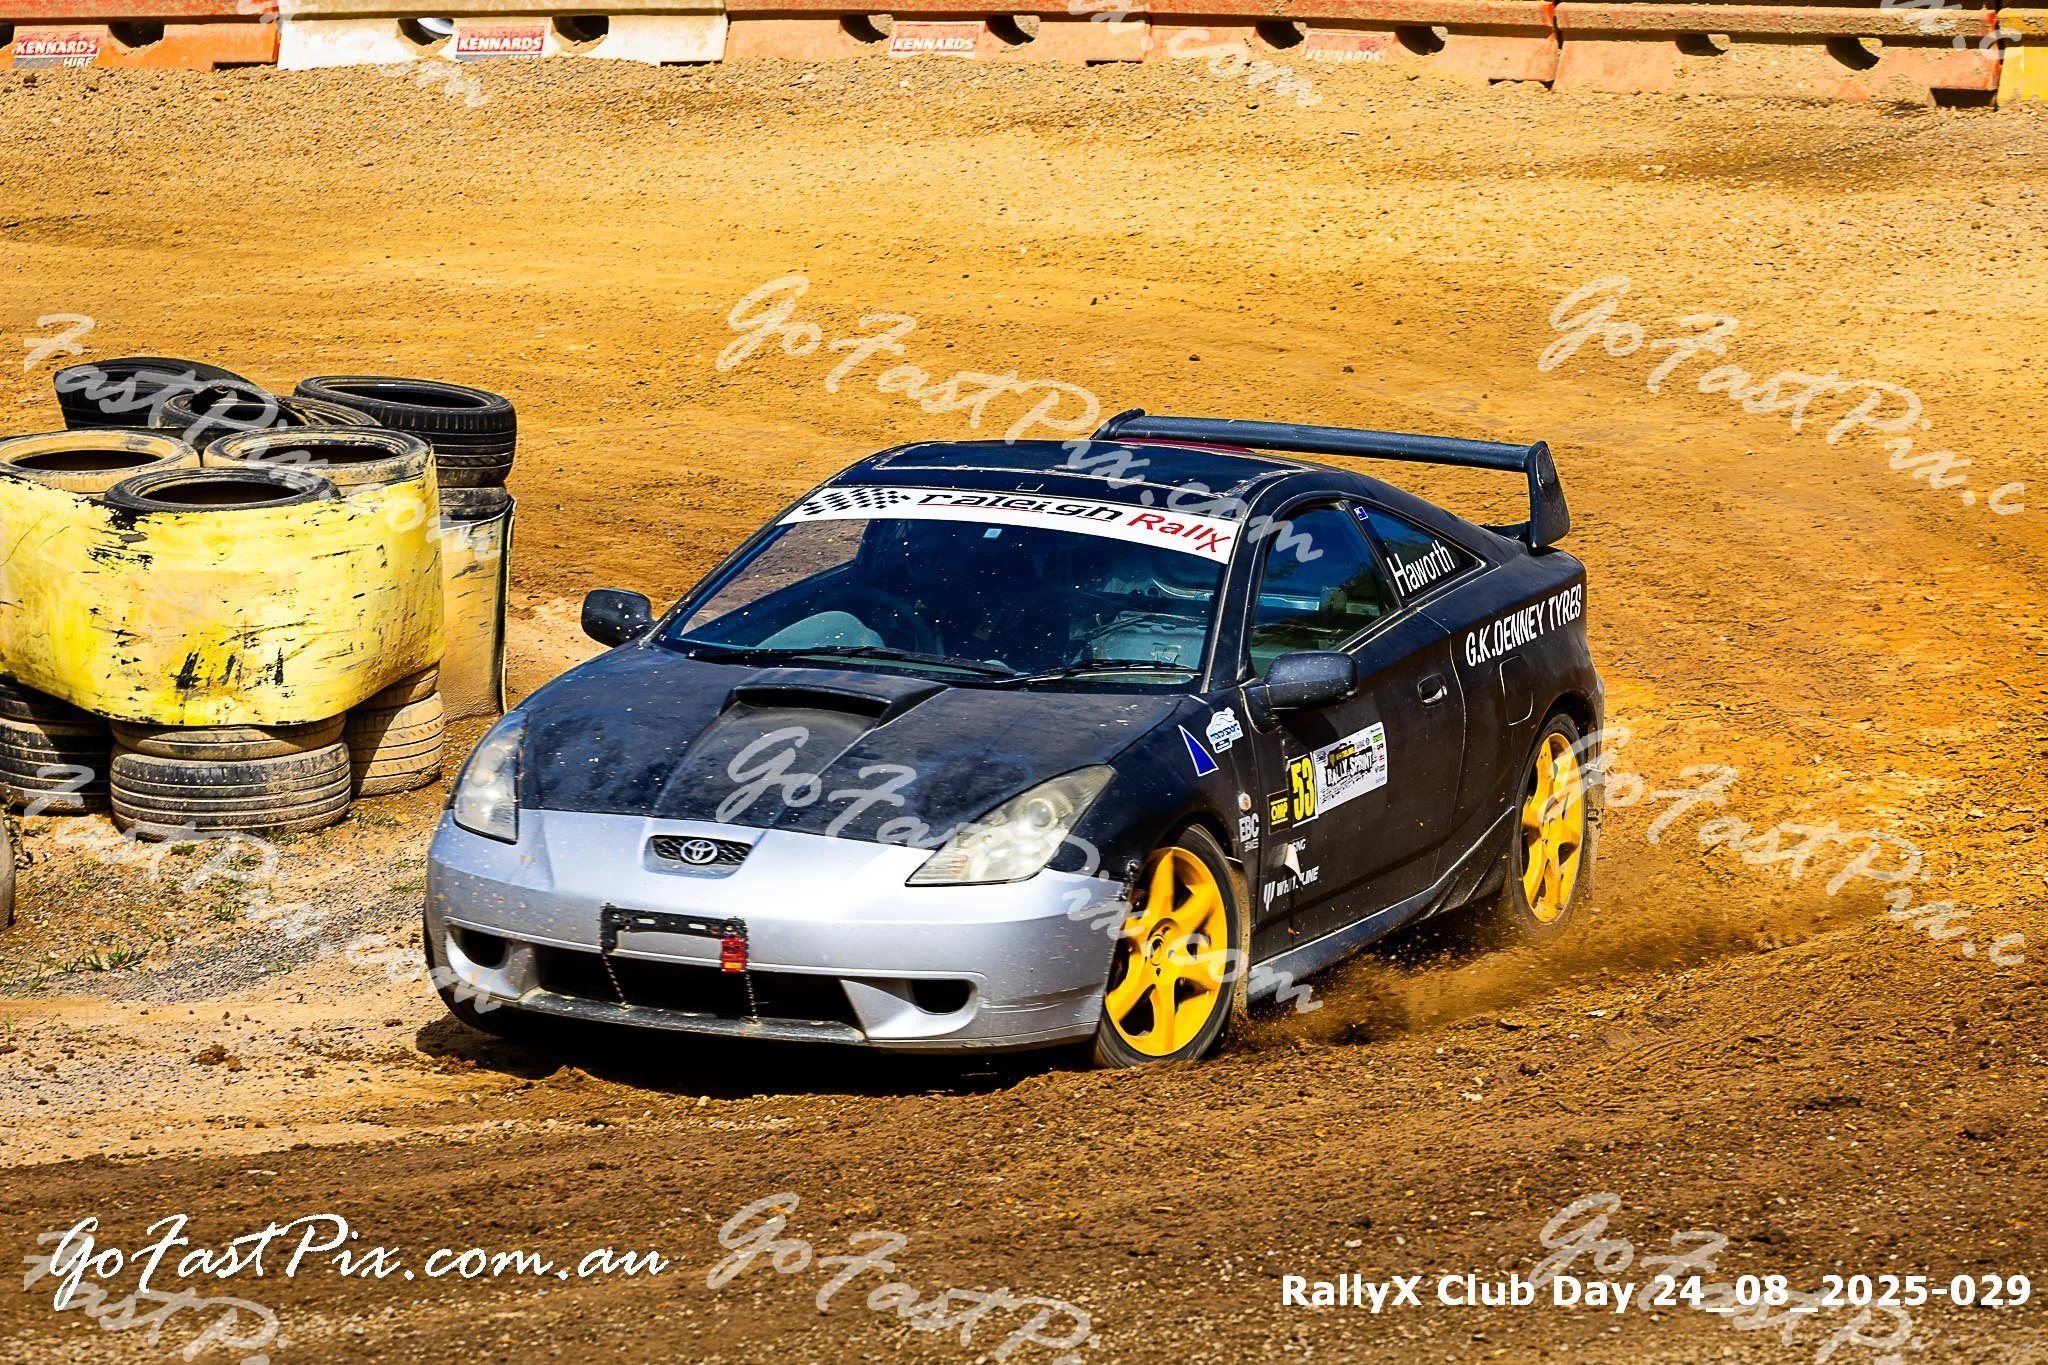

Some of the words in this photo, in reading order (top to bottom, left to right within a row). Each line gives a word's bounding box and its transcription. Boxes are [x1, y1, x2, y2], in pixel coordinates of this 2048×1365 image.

[15, 40, 97, 54] KENNARDS
[458, 37, 543, 51] KENNARDS
[894, 38, 976, 50] KENNARDS
[916, 492, 1124, 523] raleigh
[1386, 540, 1456, 597] Haworth
[1465, 600, 1546, 667] G.K.DENNEY
[1549, 584, 1582, 632] TYRES
[1291, 758, 1315, 820] 53
[1271, 801, 1288, 821] OMP
[1239, 813, 1260, 842] EBC
